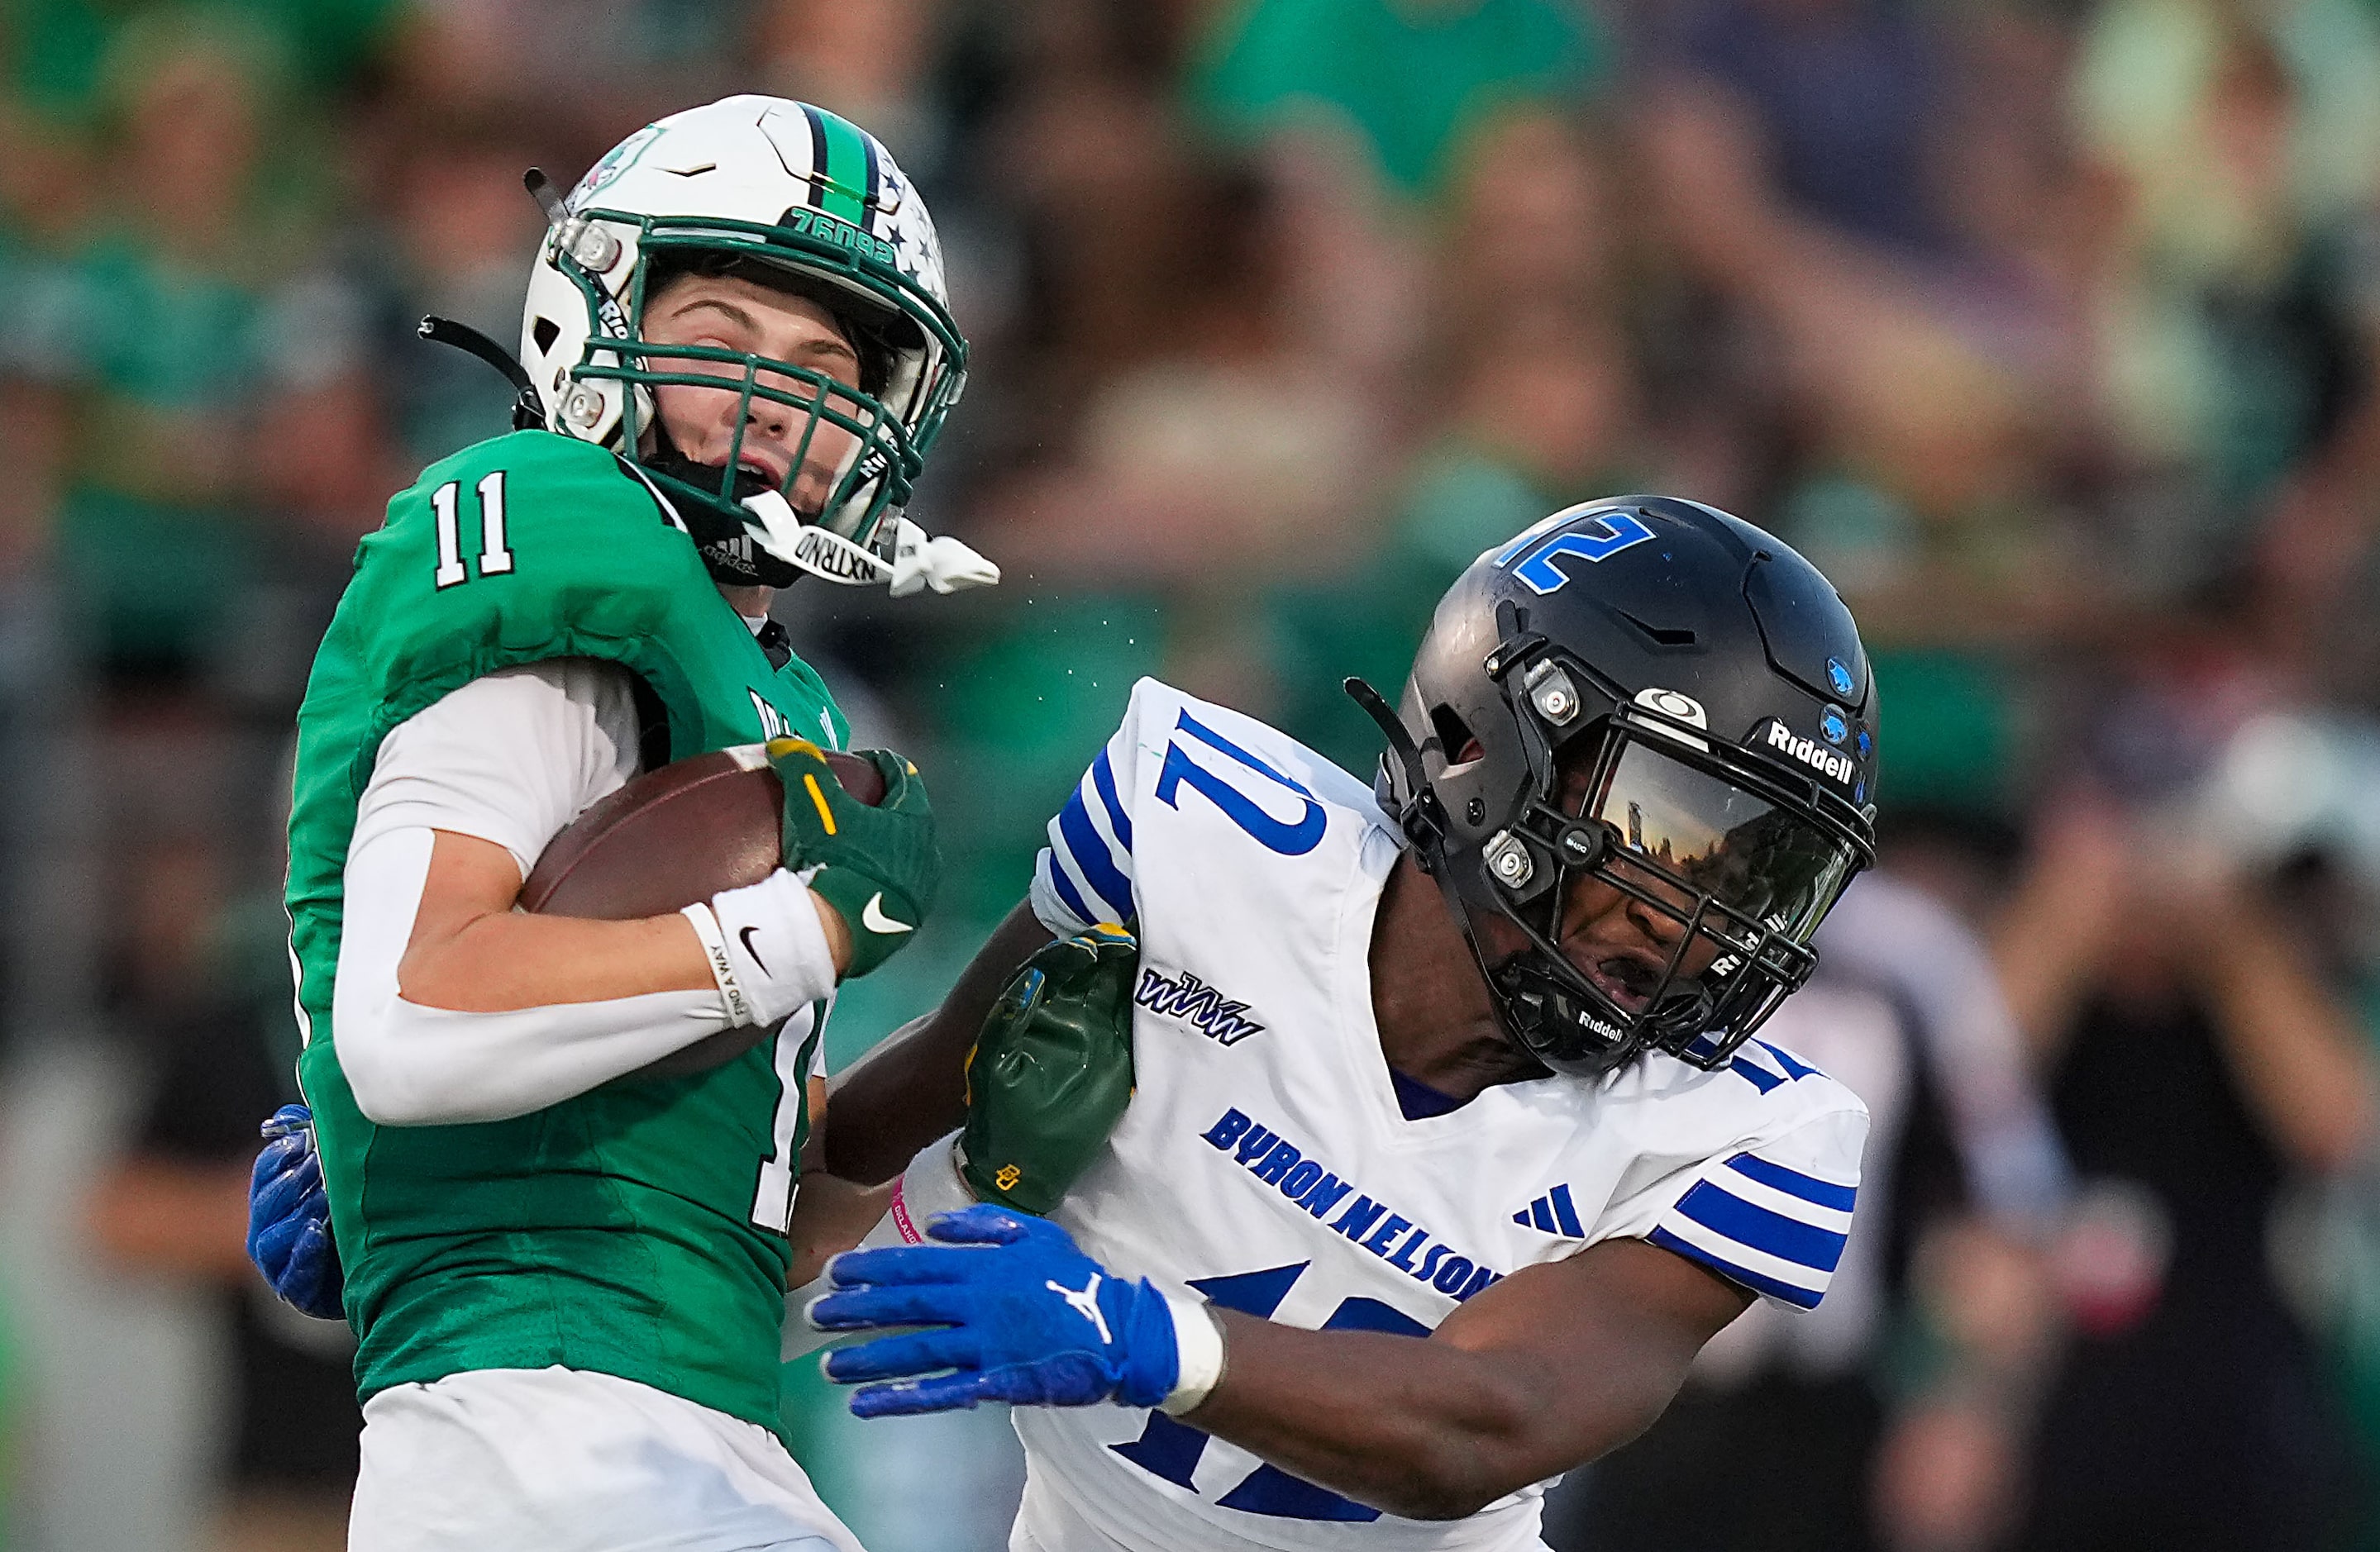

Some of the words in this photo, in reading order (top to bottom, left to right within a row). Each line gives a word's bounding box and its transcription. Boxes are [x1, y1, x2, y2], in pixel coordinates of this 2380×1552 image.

[432, 470, 514, 592] 11
[1767, 721, 1853, 784] Riddell
[1578, 1010, 1624, 1043] Riddell
[1199, 1106, 1354, 1219] BYRON
[1326, 1193, 1507, 1303] NELSON
